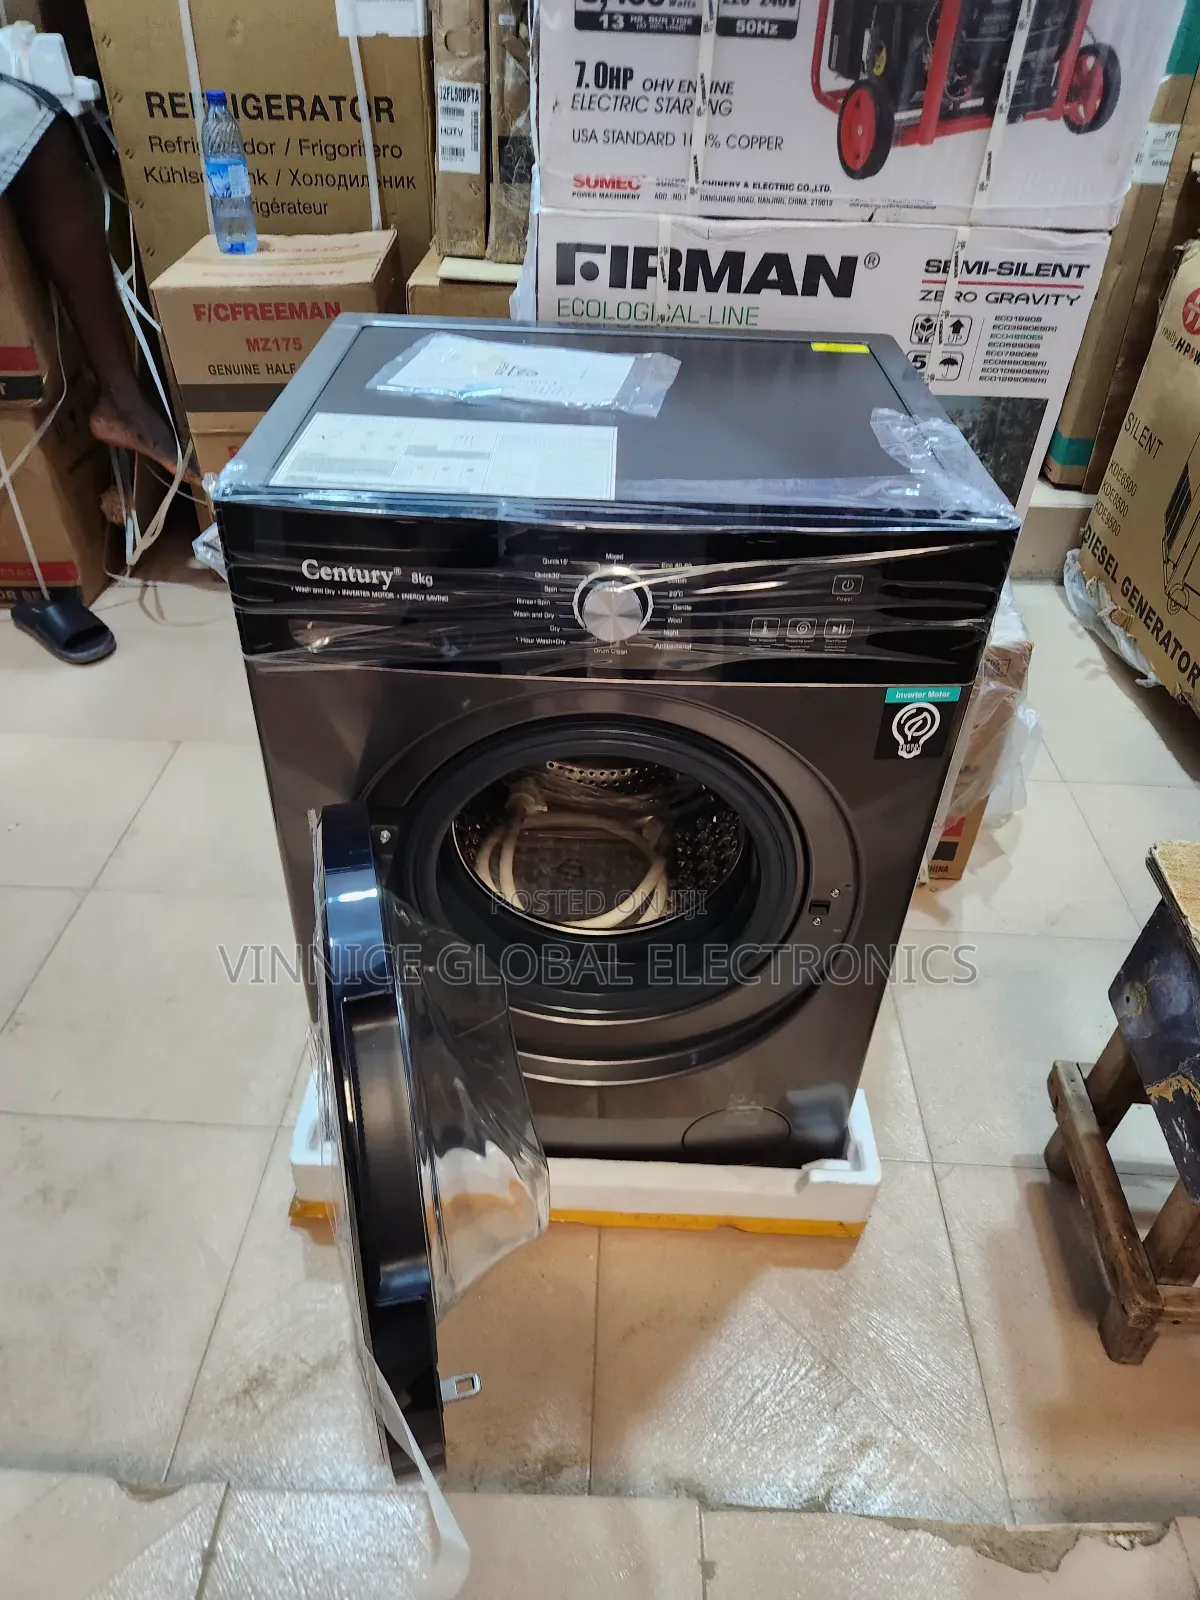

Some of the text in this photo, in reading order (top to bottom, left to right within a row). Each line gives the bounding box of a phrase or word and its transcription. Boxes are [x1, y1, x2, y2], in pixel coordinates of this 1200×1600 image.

[599, 13, 625, 30] 13
[735, 19, 779, 36] 50Hz
[574, 60, 735, 96] 7.0HP OHV ENINE
[145, 91, 395, 123] REIGERATOR
[571, 92, 733, 117] ELECTRIC STARNG
[148, 135, 276, 157] Refridor
[299, 138, 403, 161] Frigoriero
[571, 128, 784, 151] USA STANDARD 1% COPPER
[144, 165, 268, 186] Kühlsnk
[573, 174, 642, 191] SUMEC
[752, 181, 794, 192] ELECTRIC
[598, 192, 641, 200] MACHINERY
[556, 242, 858, 298] FIRMAN
[924, 258, 1090, 278] SEMI-SILENT
[918, 289, 1081, 307] ZERO GRAVITY
[193, 301, 341, 323] F/CFREEMAN
[246, 337, 303, 352] MZ175
[208, 363, 260, 376] GENUINE
[1124, 411, 1164, 460] SILENT
[605, 552, 624, 561] Mixed
[301, 558, 434, 591] Century 8kg
[341, 588, 371, 598] INVERTER
[371, 590, 395, 600] MOTOR
[401, 592, 425, 601] ENERGY
[425, 593, 449, 603] SAVING
[544, 611, 555, 620] Dry
[1082, 523, 1200, 690] DIESEL GENERATOR
[549, 624, 561, 633] Dry
[895, 690, 951, 699] Inverter Motor
